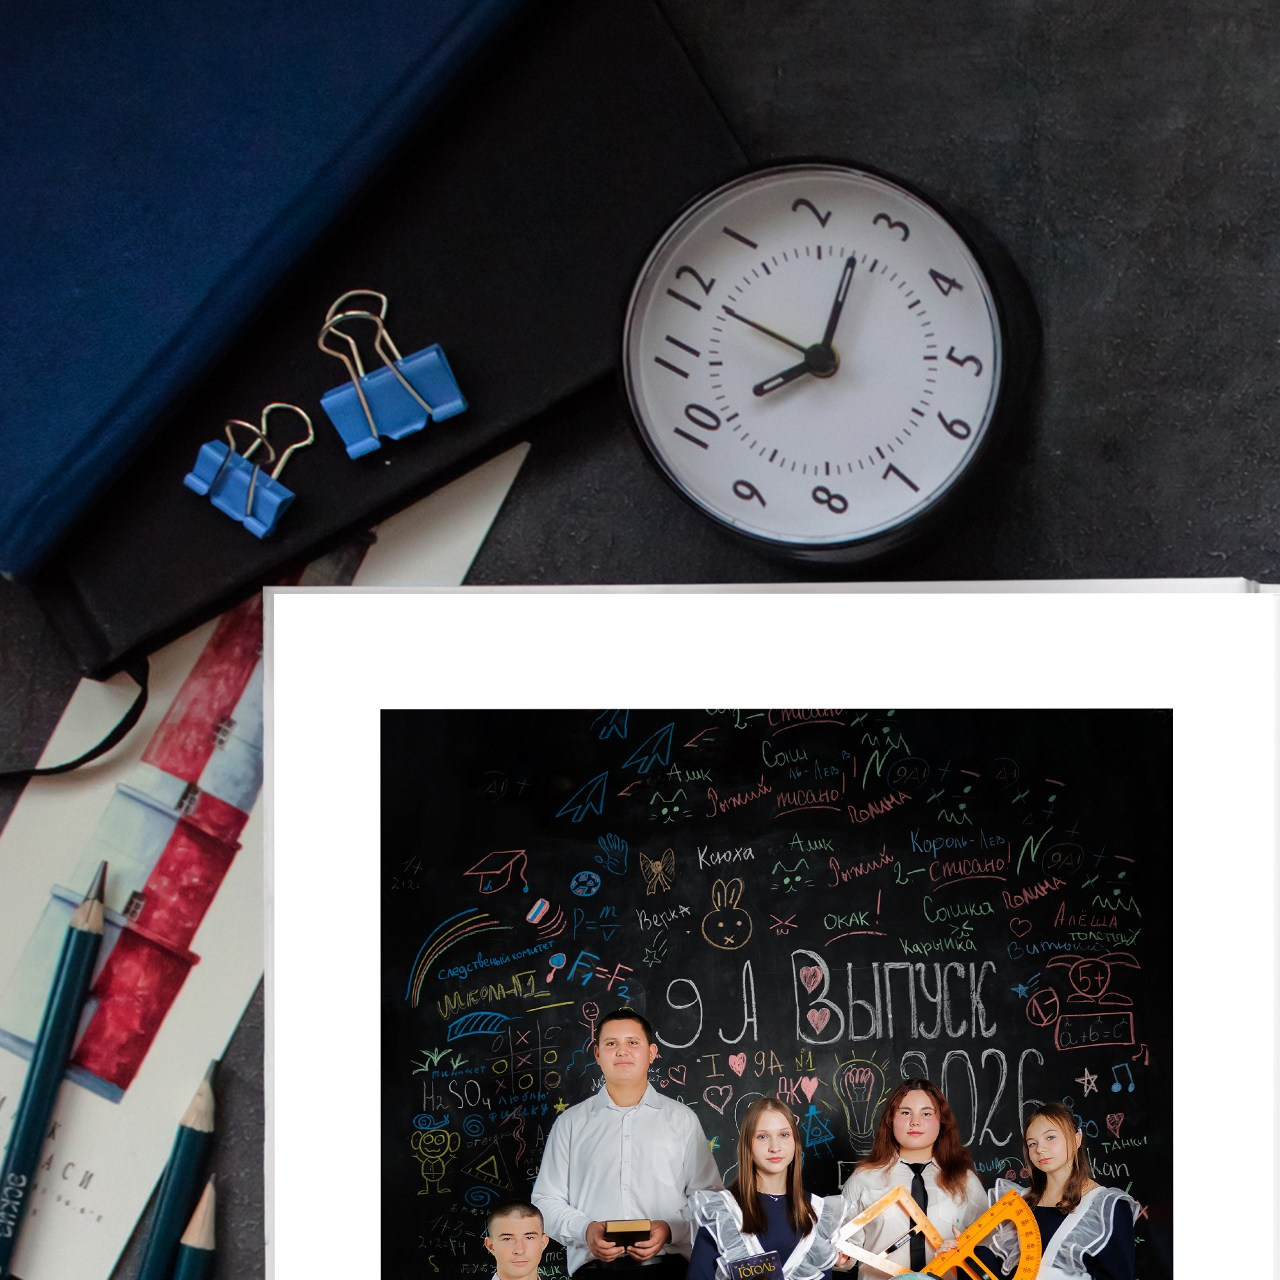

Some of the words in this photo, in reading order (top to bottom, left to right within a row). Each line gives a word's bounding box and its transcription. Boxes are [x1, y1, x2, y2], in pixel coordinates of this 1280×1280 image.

[792, 198, 831, 228] 2
[873, 213, 910, 241] 3
[723, 226, 758, 249] 1
[667, 265, 716, 310] 12
[928, 268, 963, 296] 4
[654, 335, 700, 378] 11
[946, 346, 982, 376] 5
[674, 403, 722, 449] 10
[937, 411, 970, 440] 6
[882, 462, 920, 492] 7
[732, 480, 767, 507] 9
[812, 486, 848, 514] 8
[655, 978, 703, 1048] 9
[738, 1262, 776, 1278] ГОГОЛЬ
